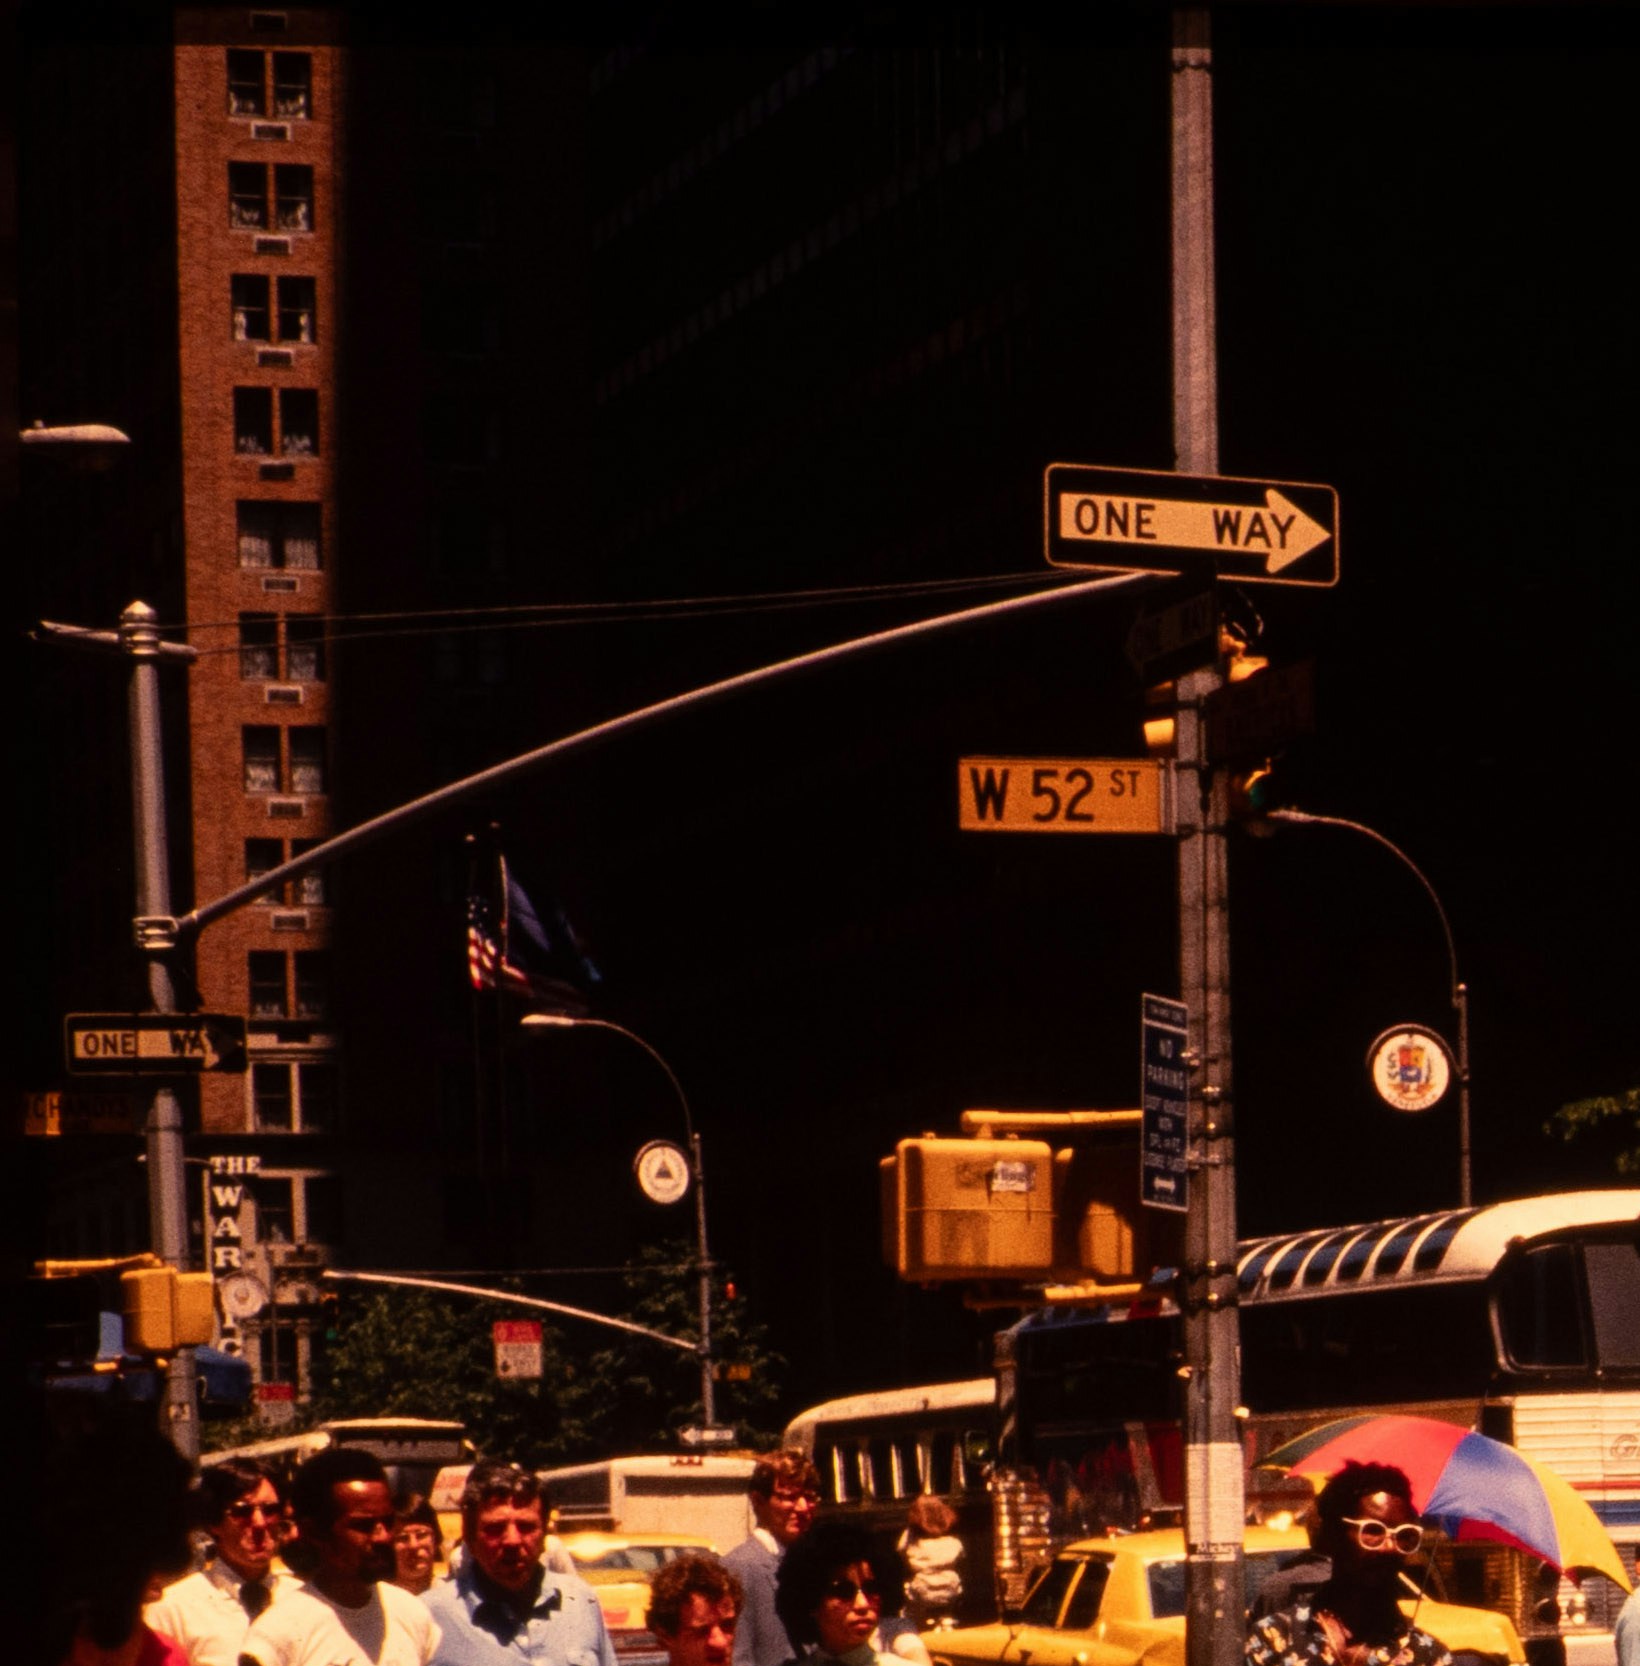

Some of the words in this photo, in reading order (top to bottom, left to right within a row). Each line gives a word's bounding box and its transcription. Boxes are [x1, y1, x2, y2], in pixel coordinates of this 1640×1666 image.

[1073, 498, 1157, 540] ONE
[1213, 508, 1297, 550] WAY
[970, 768, 1010, 823] W
[1031, 768, 1095, 823] 52
[1109, 768, 1141, 798] ST
[83, 1032, 136, 1056] ONE
[209, 1156, 262, 1175] THE
